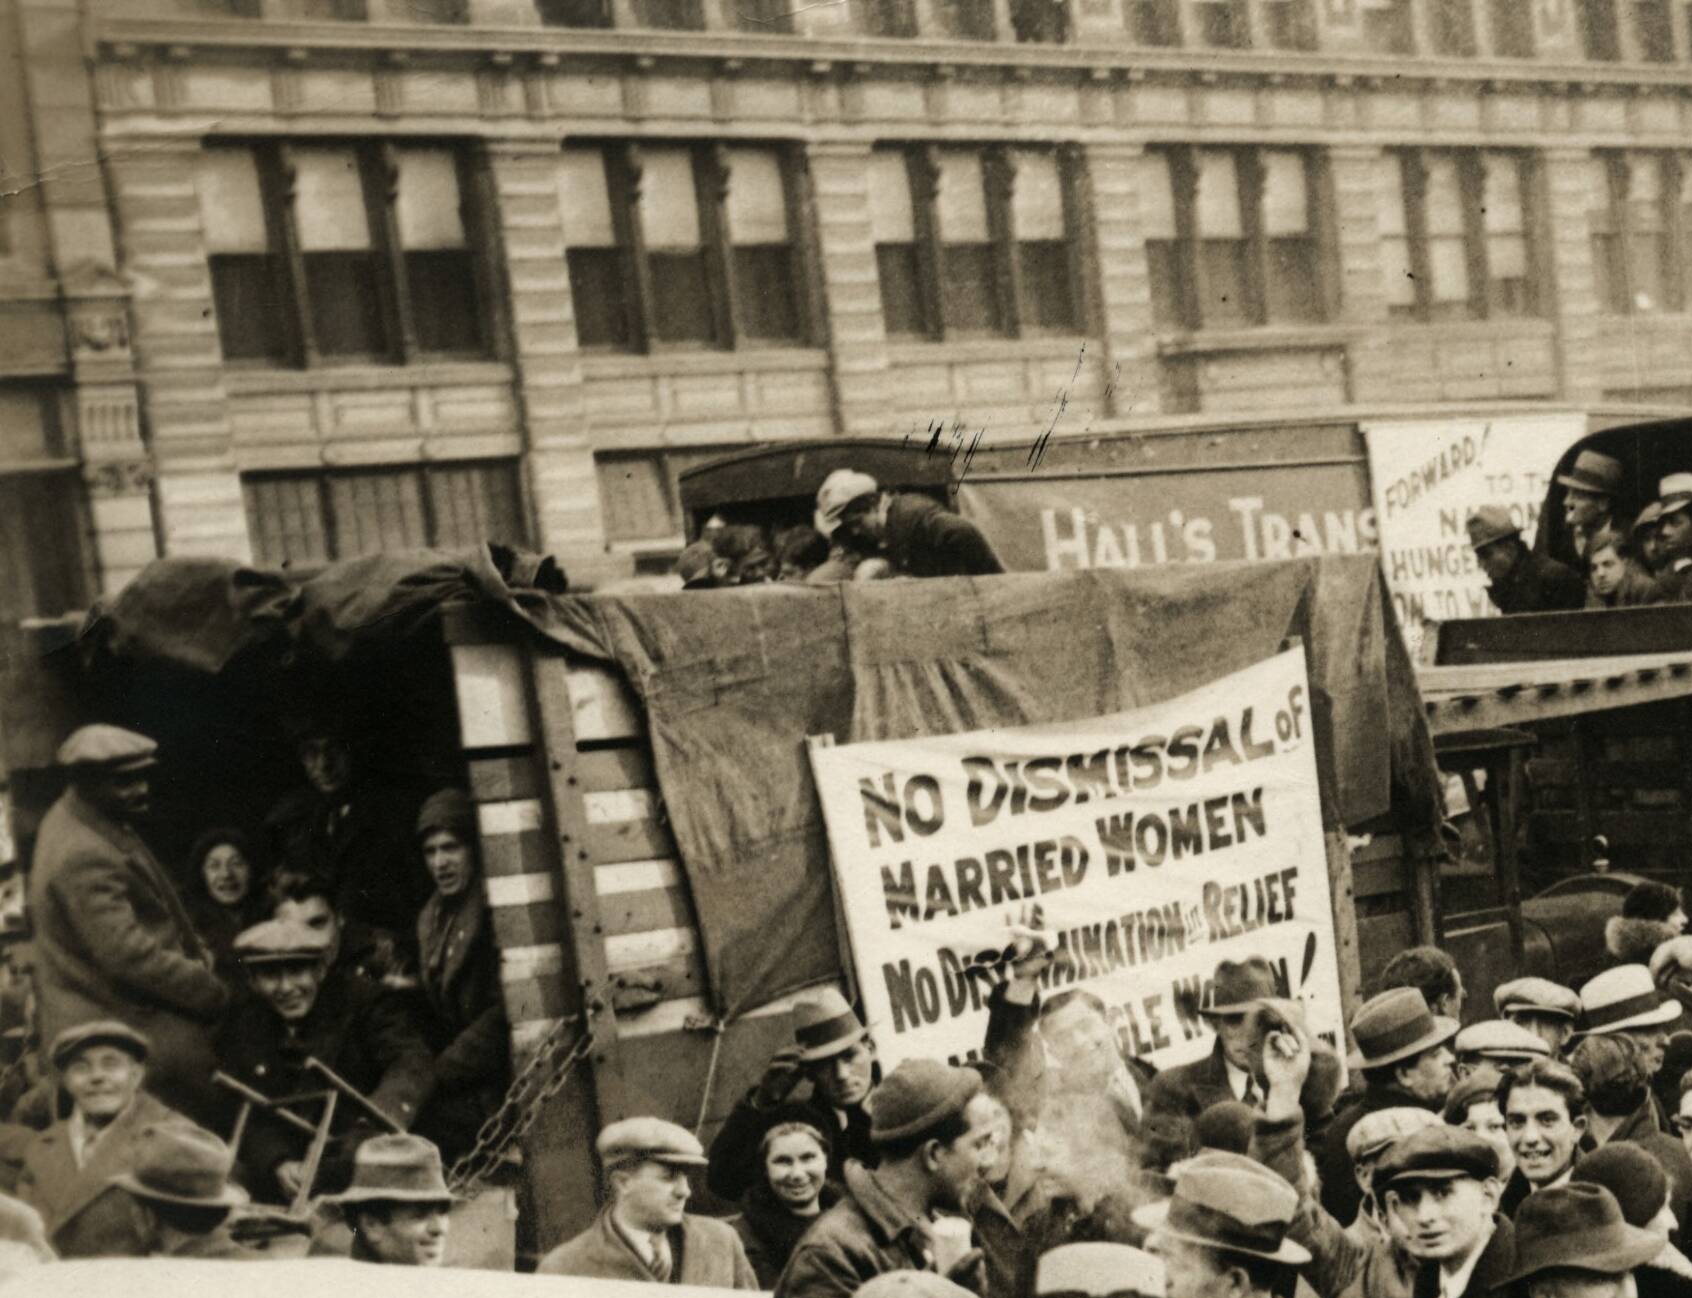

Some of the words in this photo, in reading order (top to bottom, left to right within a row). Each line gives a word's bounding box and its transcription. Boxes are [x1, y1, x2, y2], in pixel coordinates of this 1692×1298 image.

[1385, 423, 1491, 518] FORWARD!
[1391, 545, 1478, 581] HUNGE
[859, 773, 946, 847] NO
[962, 706, 1275, 826] DISMISSAL
[881, 835, 1090, 929] MARRIED
[1094, 787, 1267, 877] WOMEN
[1202, 866, 1298, 944] RELIEF
